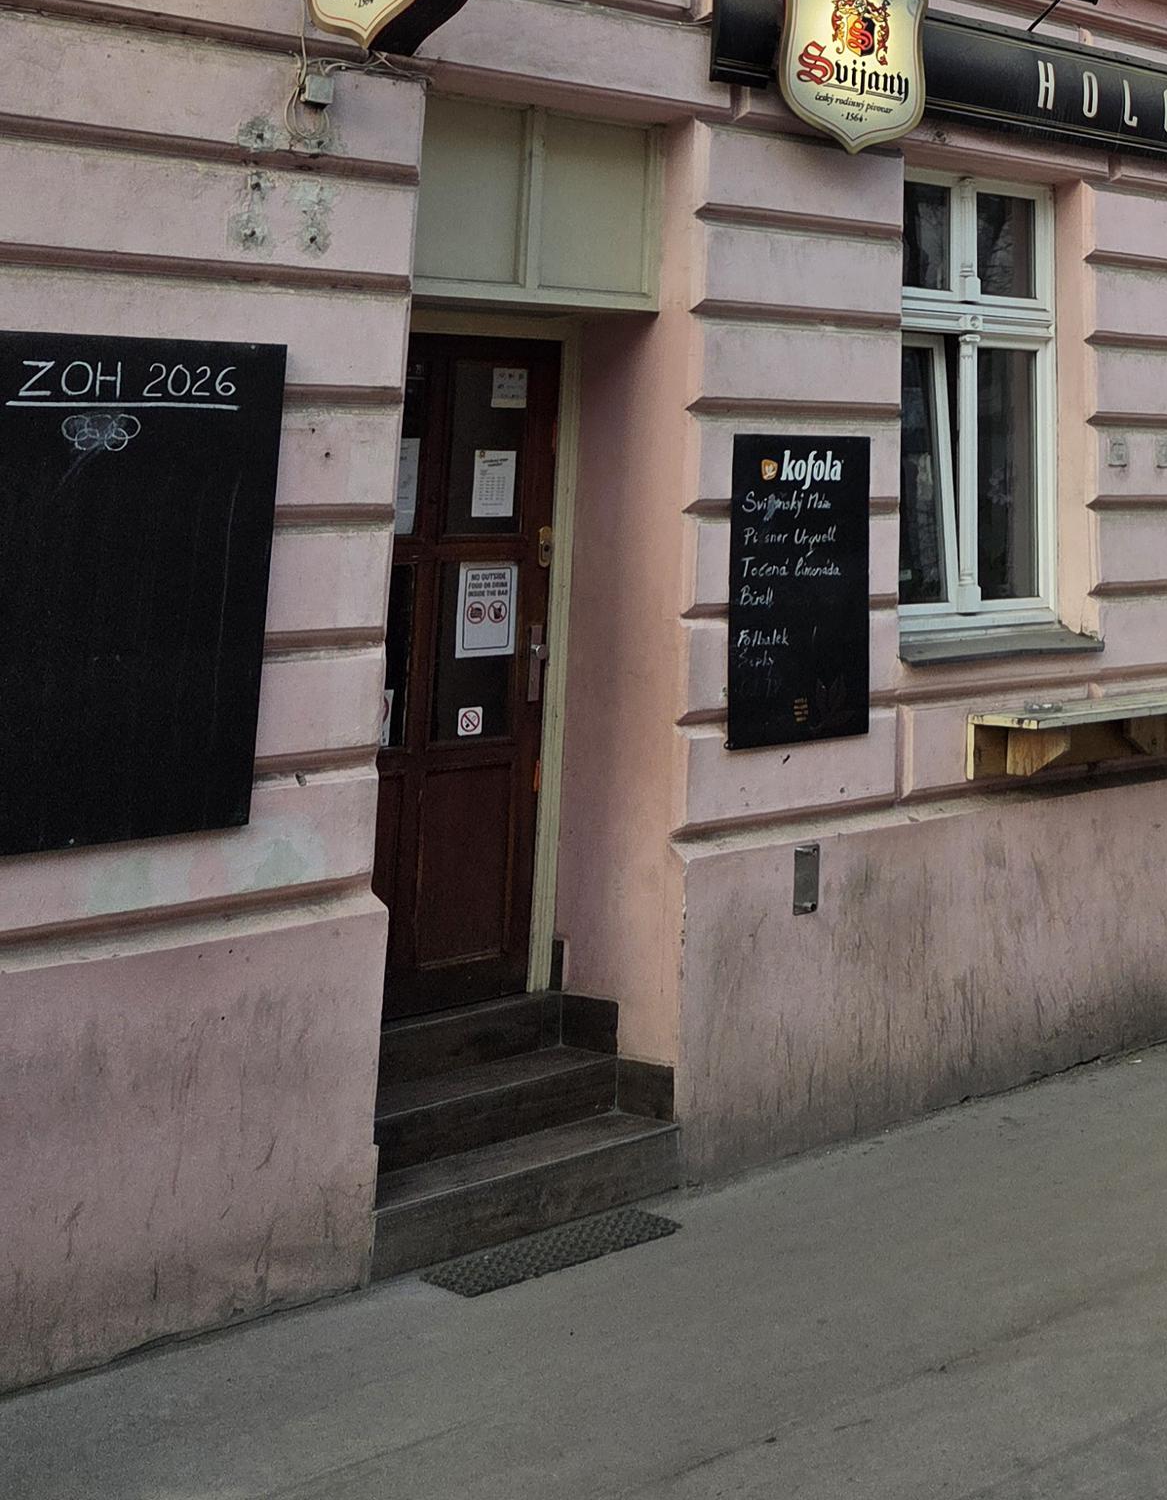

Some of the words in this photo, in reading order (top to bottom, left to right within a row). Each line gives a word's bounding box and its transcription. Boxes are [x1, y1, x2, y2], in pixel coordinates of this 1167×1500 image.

[796, 40, 909, 105] Svijany
[845, 112, 864, 122] 1564
[18, 360, 122, 398] ZOH
[142, 362, 237, 396] 2026
[780, 449, 842, 490] kofola
